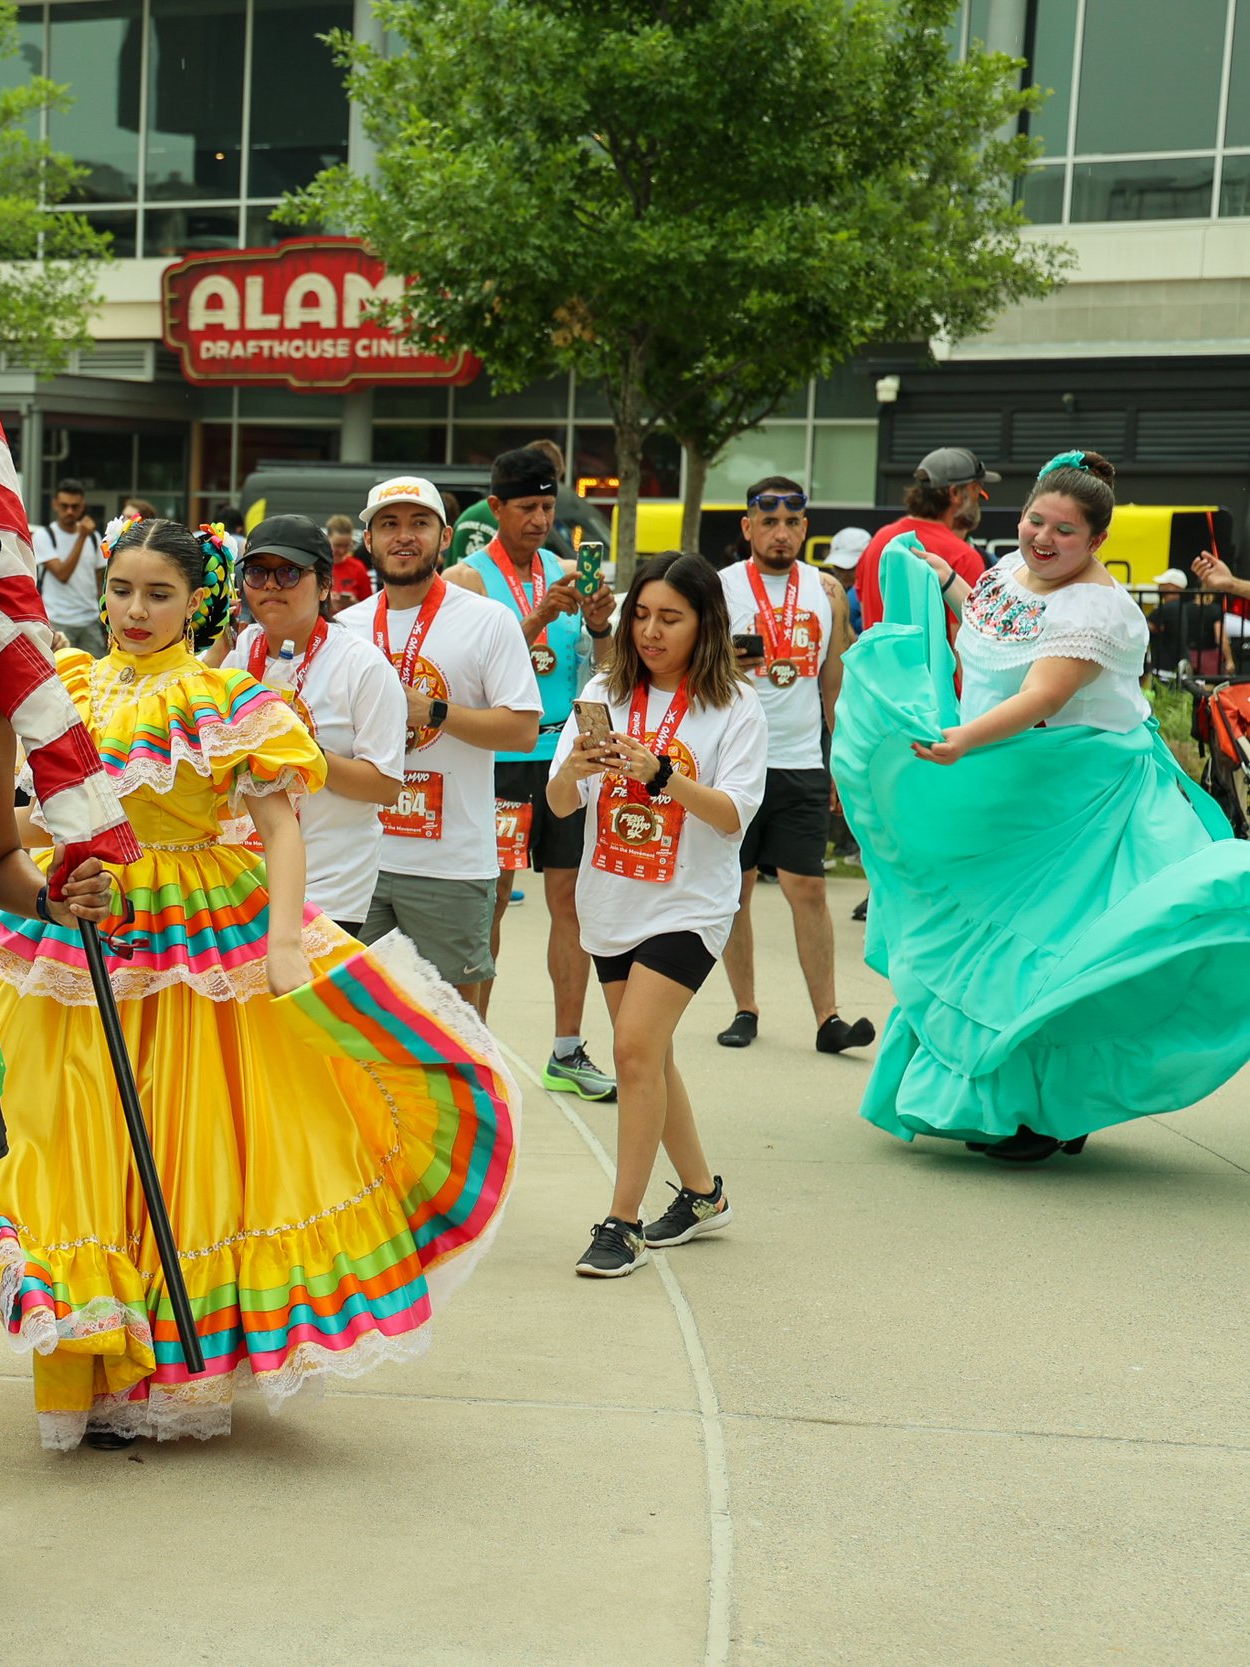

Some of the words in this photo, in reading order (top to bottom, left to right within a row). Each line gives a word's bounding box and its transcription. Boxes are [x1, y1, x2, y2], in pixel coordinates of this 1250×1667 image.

[188, 272, 412, 331] ALAM
[200, 338, 351, 360] DRAFTHOUSE
[378, 484, 421, 501] HOKA
[405, 636, 418, 662] MAYO
[412, 620, 425, 636] 5K
[631, 710, 642, 737] IRVING
[657, 725, 671, 751] MAYO
[665, 708, 679, 724] 5K
[407, 772, 431, 783] MAYO
[610, 807, 665, 842] 16
[626, 829, 643, 840] 5K
[609, 844, 619, 852] Join
[628, 848, 656, 860] Movement
